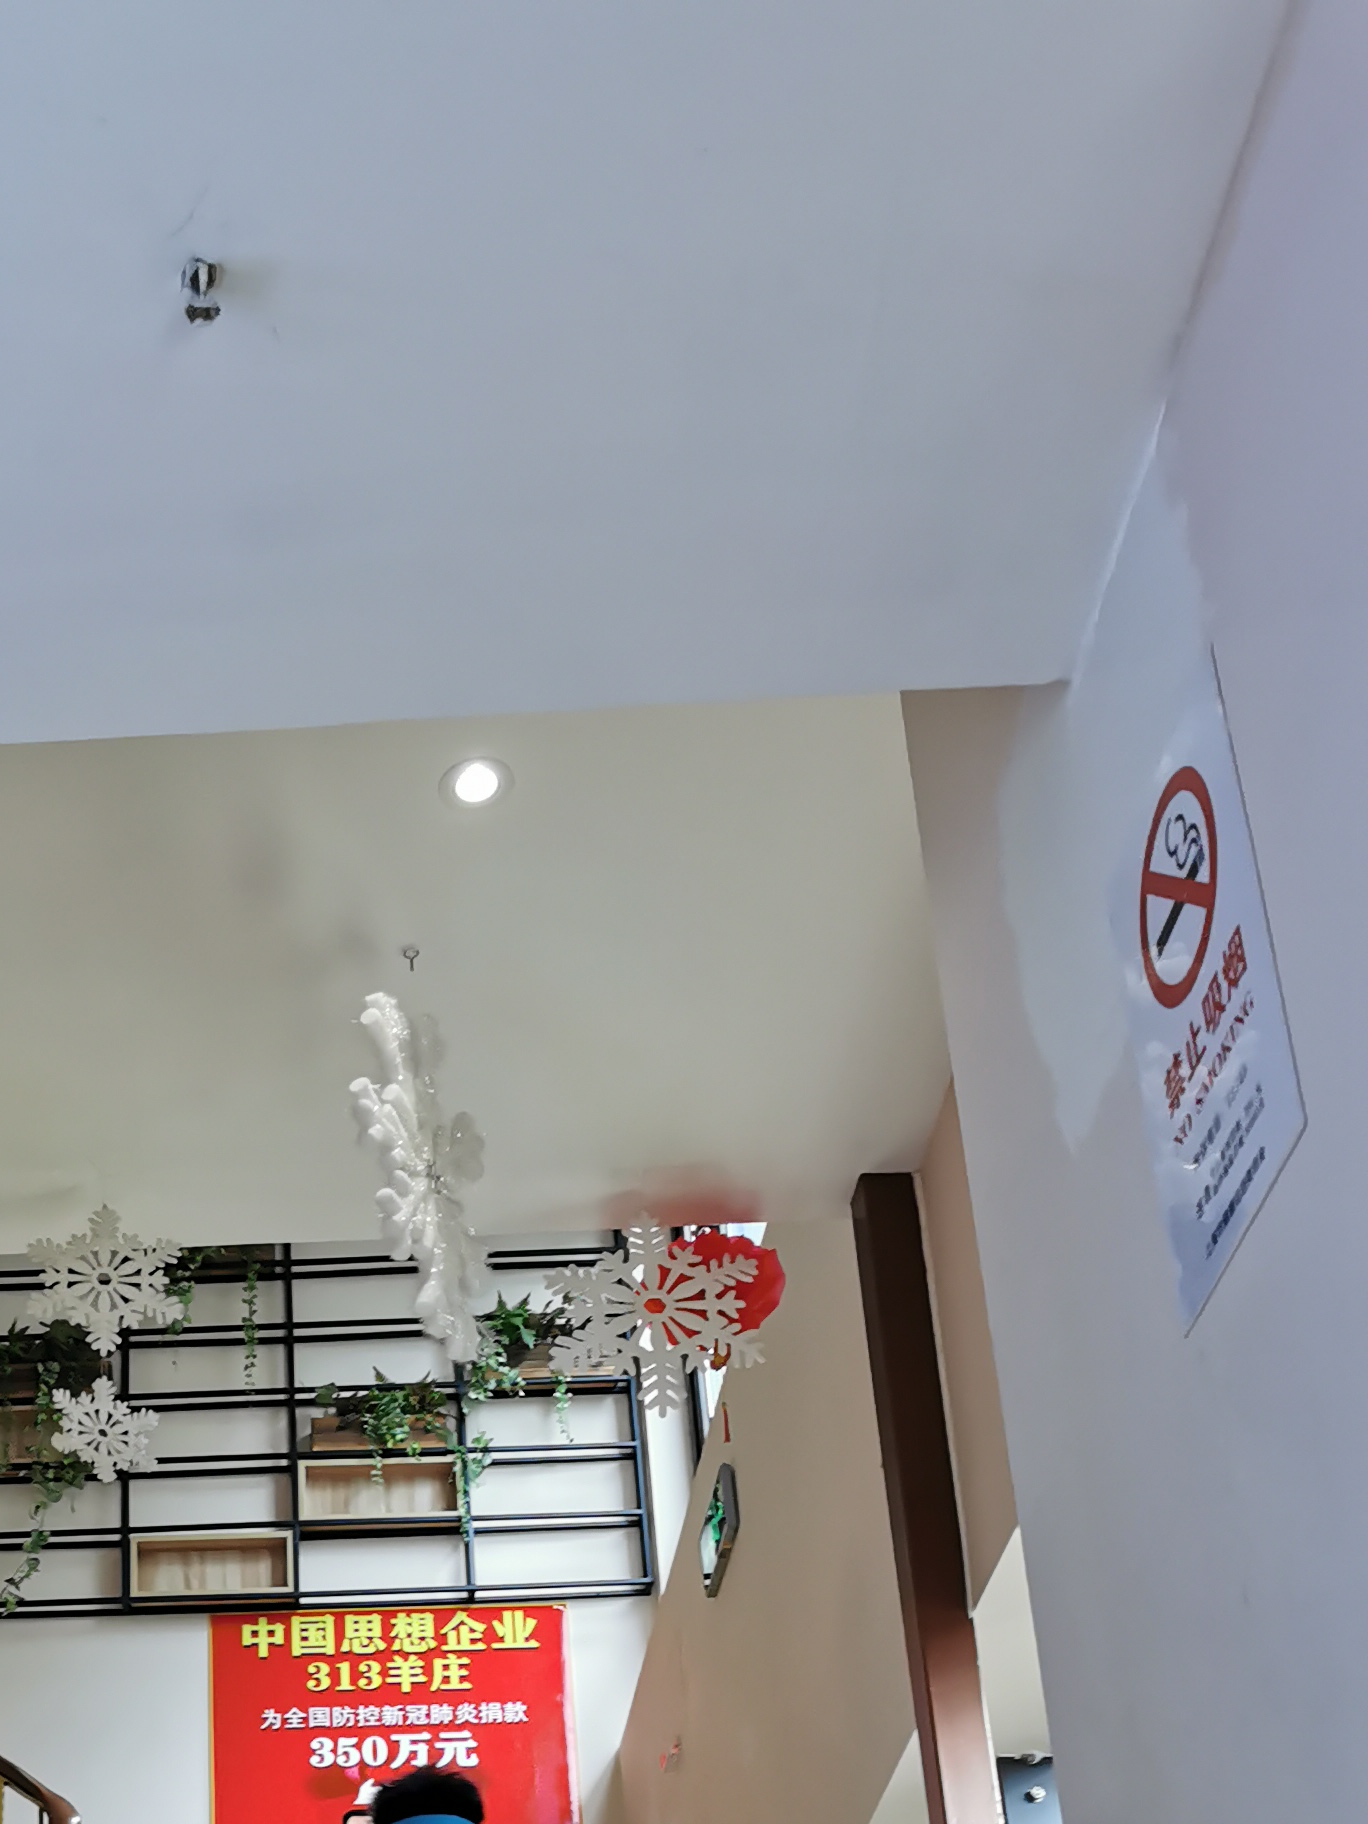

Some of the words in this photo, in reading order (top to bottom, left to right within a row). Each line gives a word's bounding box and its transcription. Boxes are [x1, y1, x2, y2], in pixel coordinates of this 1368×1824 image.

[241, 1610, 540, 1659] 中国思想企业
[305, 1655, 473, 1693] 313羊庄
[260, 1702, 528, 1730] 为全国防控新冠肺炎捐款
[309, 1731, 479, 1769] 350万元
